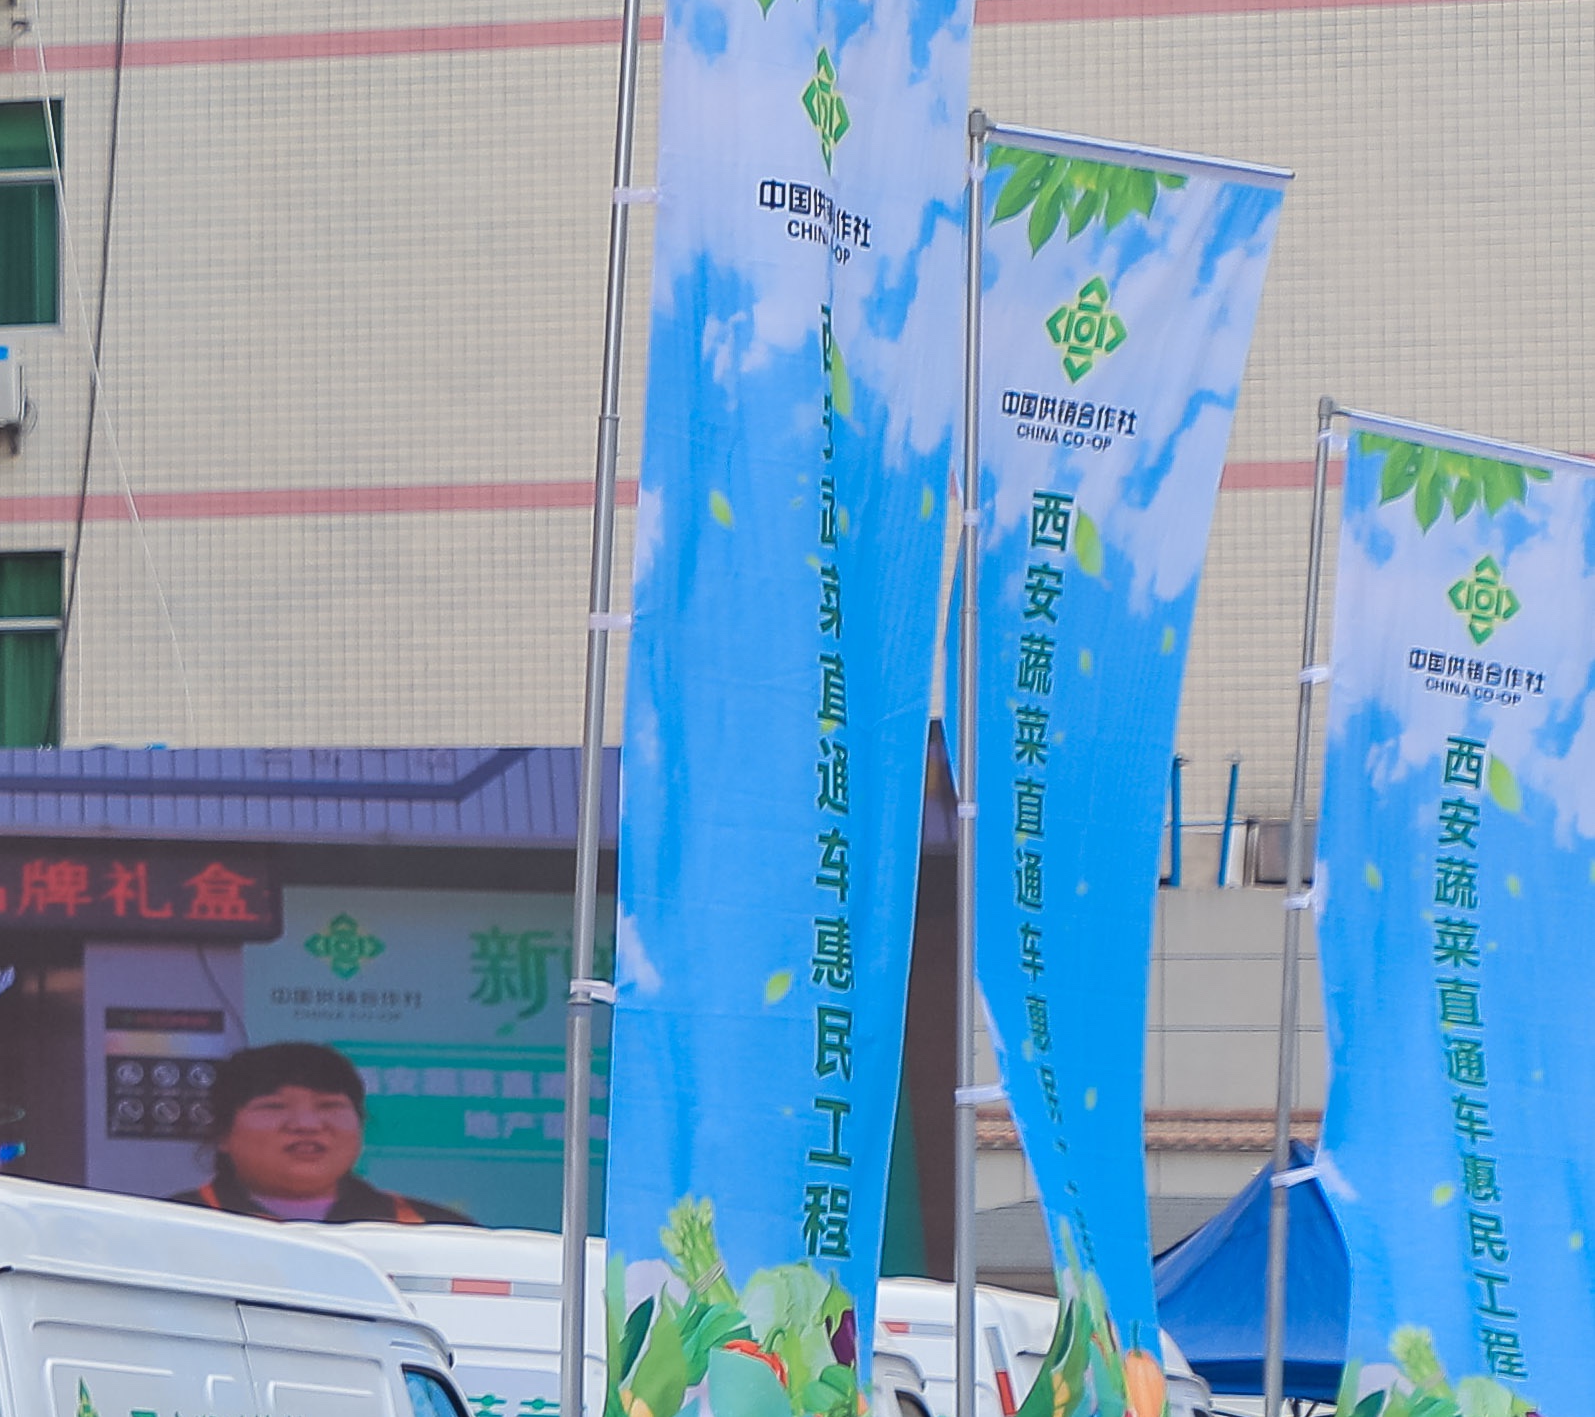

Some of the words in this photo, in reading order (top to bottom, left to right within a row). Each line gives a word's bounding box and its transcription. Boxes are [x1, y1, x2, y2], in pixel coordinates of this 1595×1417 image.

[1000, 389, 1137, 438] 中国供销合作社
[1016, 423, 1059, 446] CHINA
[1063, 427, 1112, 452] CO-OP
[1408, 648, 1545, 695] 中国供销合作社
[1424, 676, 1469, 699] CHINA
[1433, 735, 1526, 1382] 西安蔬菜直通车惠民工程
